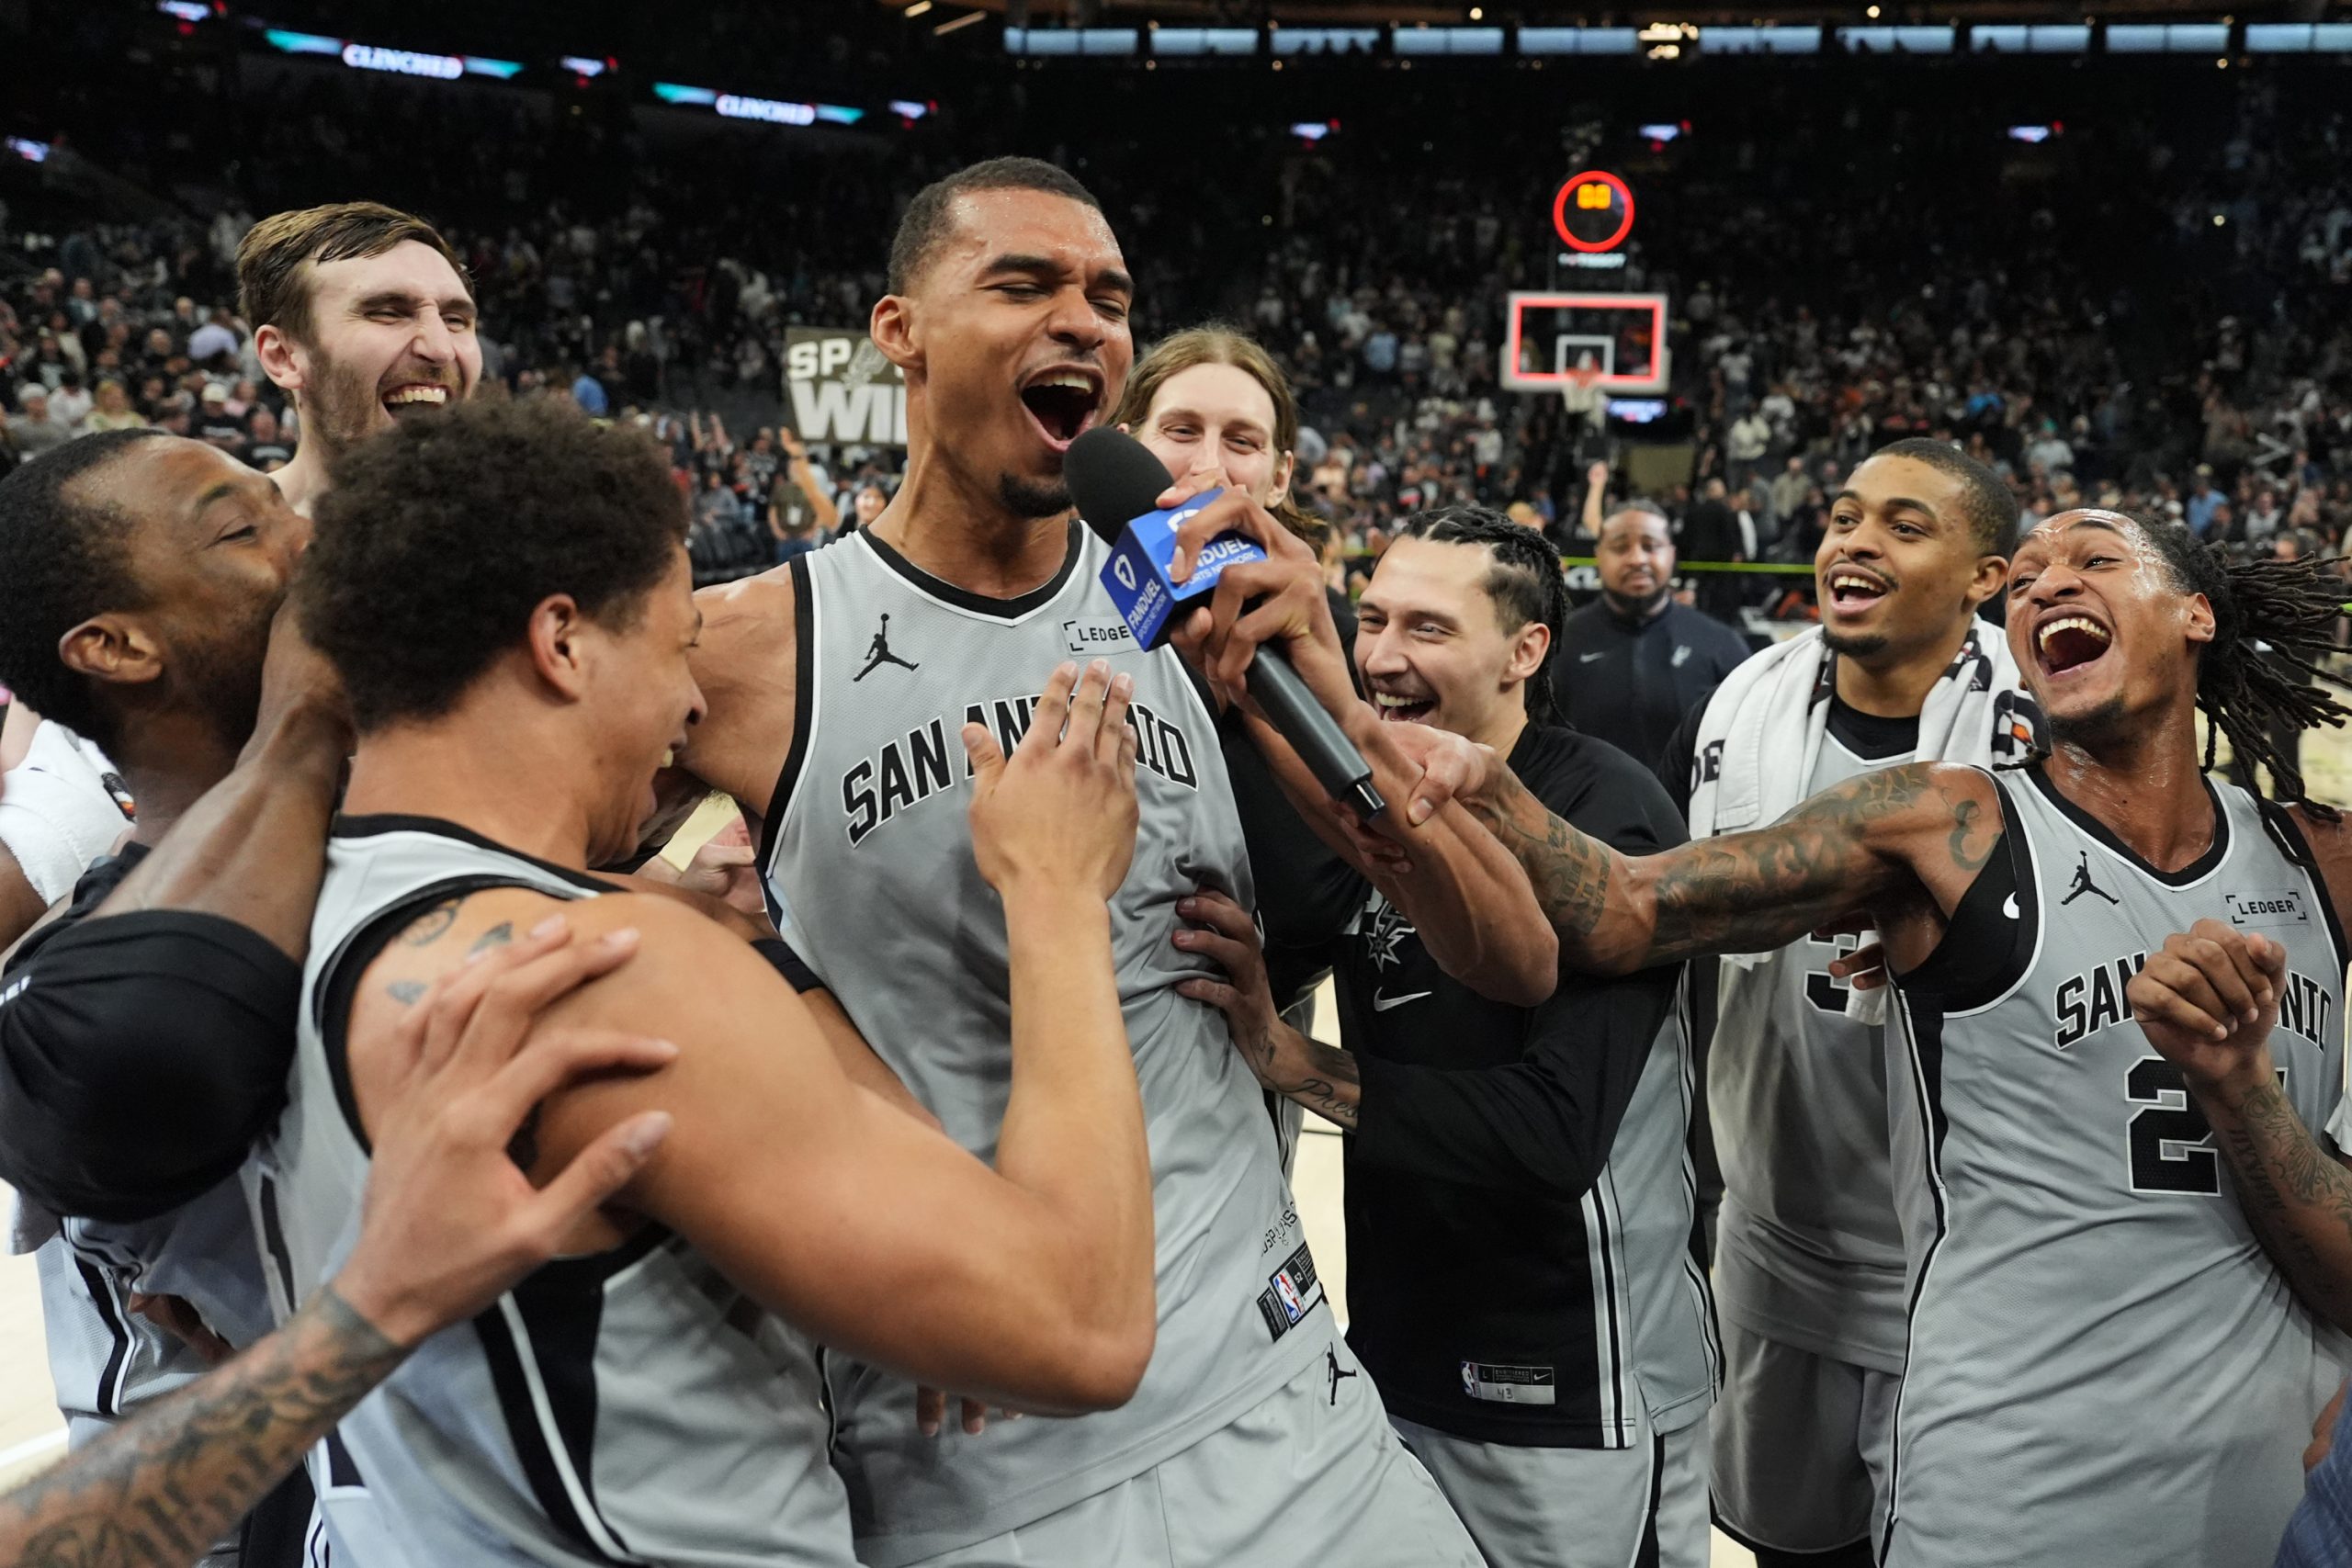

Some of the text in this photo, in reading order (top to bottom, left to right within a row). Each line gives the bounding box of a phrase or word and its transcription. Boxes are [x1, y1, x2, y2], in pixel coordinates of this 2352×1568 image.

[1126, 578, 1161, 630] FANDUEL
[1078, 626, 1130, 642] LEDGE
[841, 715, 955, 848] SAN
[2238, 899, 2296, 915] LEDGER
